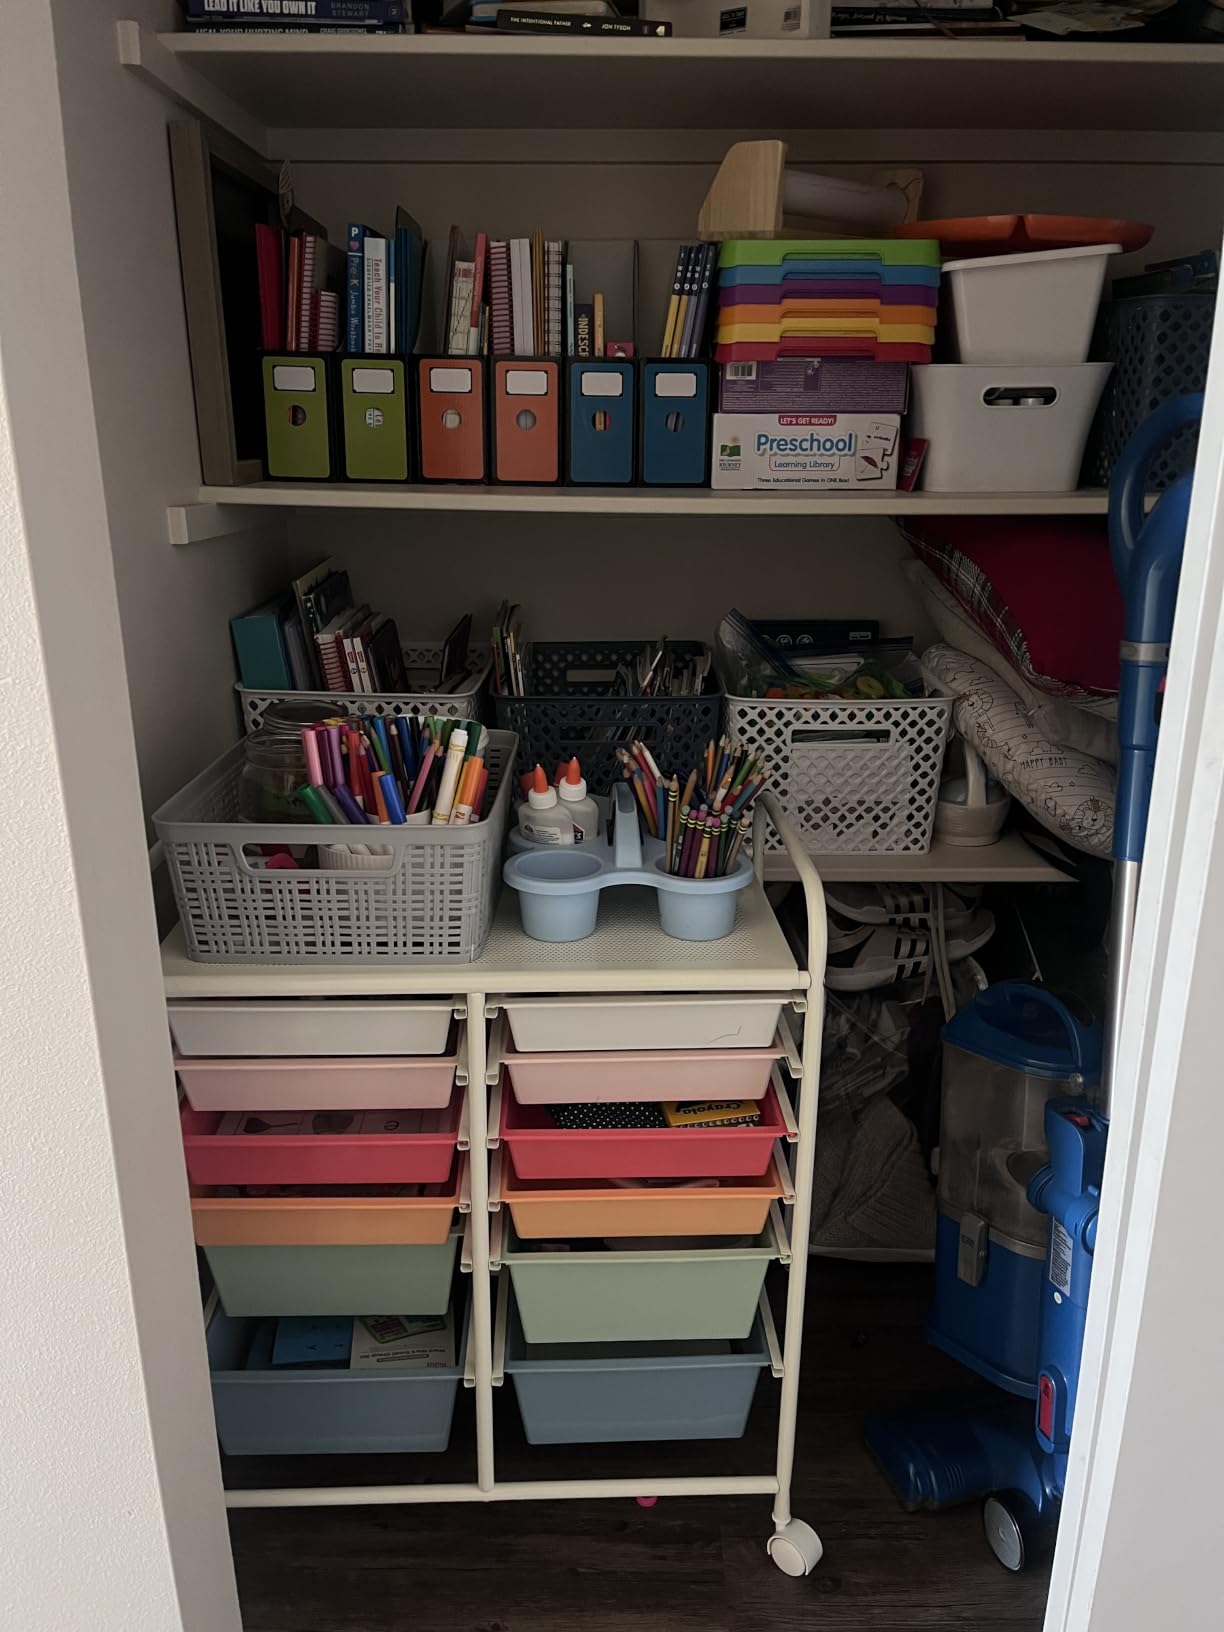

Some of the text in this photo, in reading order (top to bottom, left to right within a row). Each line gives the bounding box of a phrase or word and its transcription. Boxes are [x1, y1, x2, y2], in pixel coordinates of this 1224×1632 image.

[204, 0, 316, 15] LEAD IT LIKE YOU OWN IT
[520, 18, 553, 26] INTENTIONAL
[553, 19, 571, 27] FATHER
[373, 259, 383, 283] Teach
[374, 286, 382, 305] Your
[374, 307, 383, 329] Child
[780, 417, 834, 425] LET'S GET READY!
[756, 433, 853, 452] Preschool
[774, 460, 835, 469] Learning Library
[682, 1102, 741, 1115] Crayola
